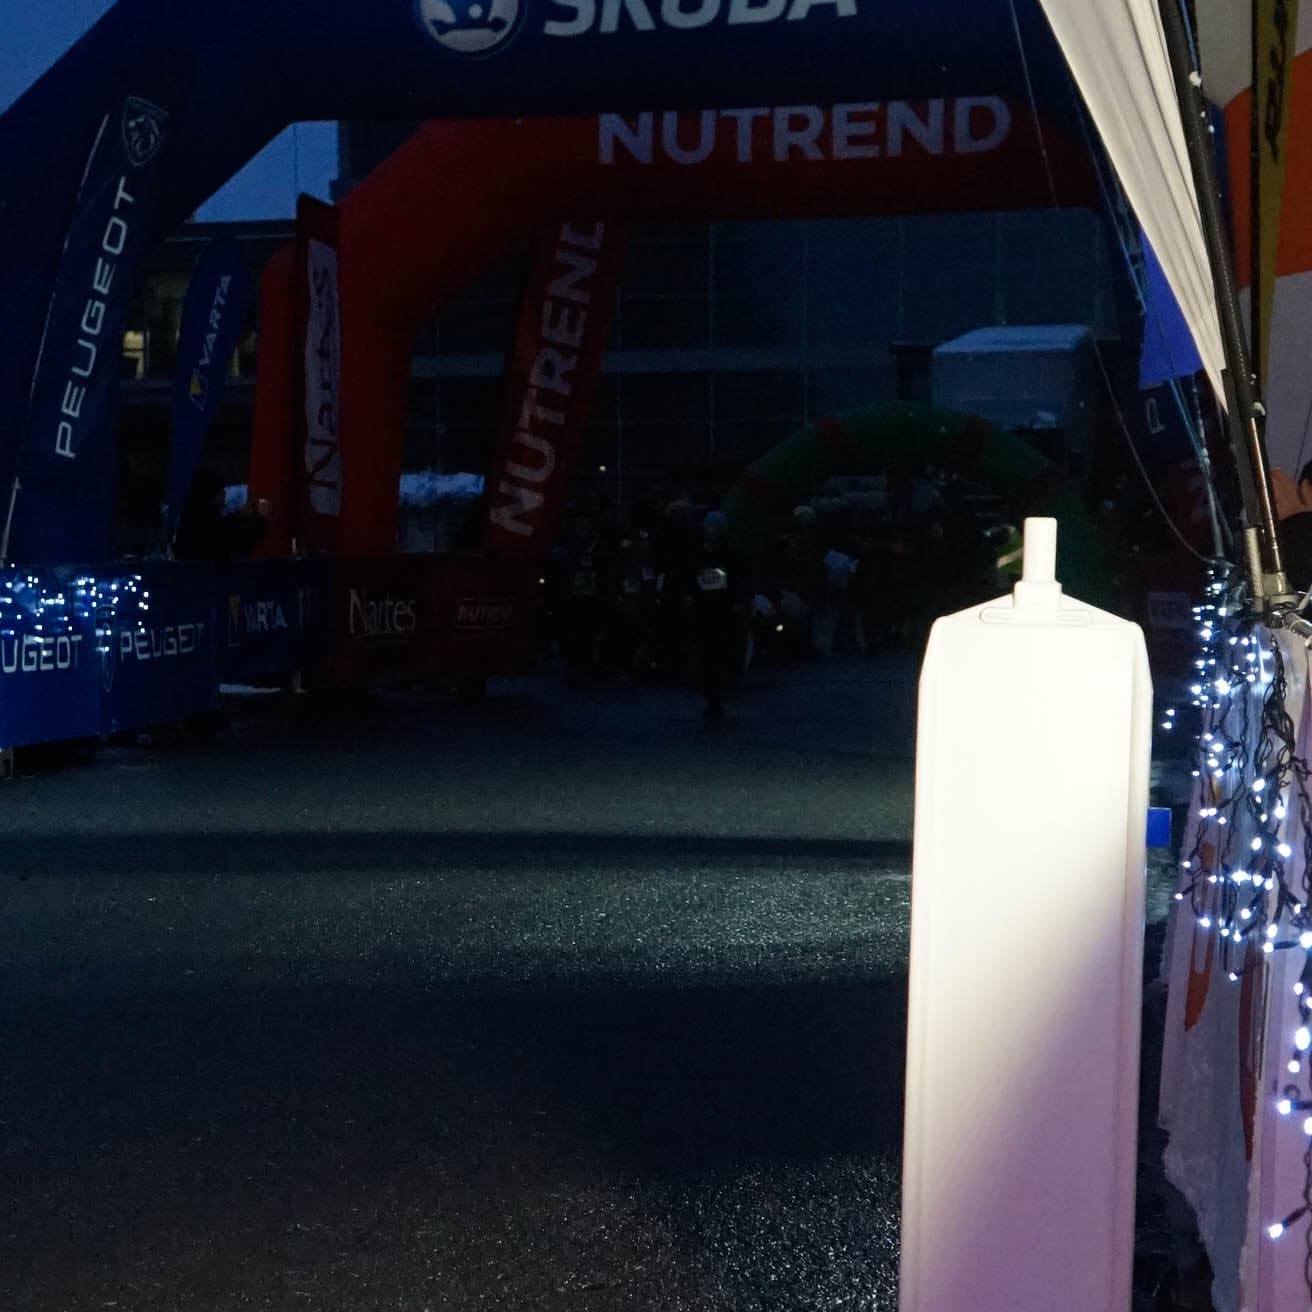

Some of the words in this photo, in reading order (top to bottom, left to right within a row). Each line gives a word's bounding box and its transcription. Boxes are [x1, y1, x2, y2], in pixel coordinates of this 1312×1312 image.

[598, 95, 1012, 167] NUTREND
[55, 176, 136, 459] PEUGEOT
[347, 587, 416, 636] Nartes
